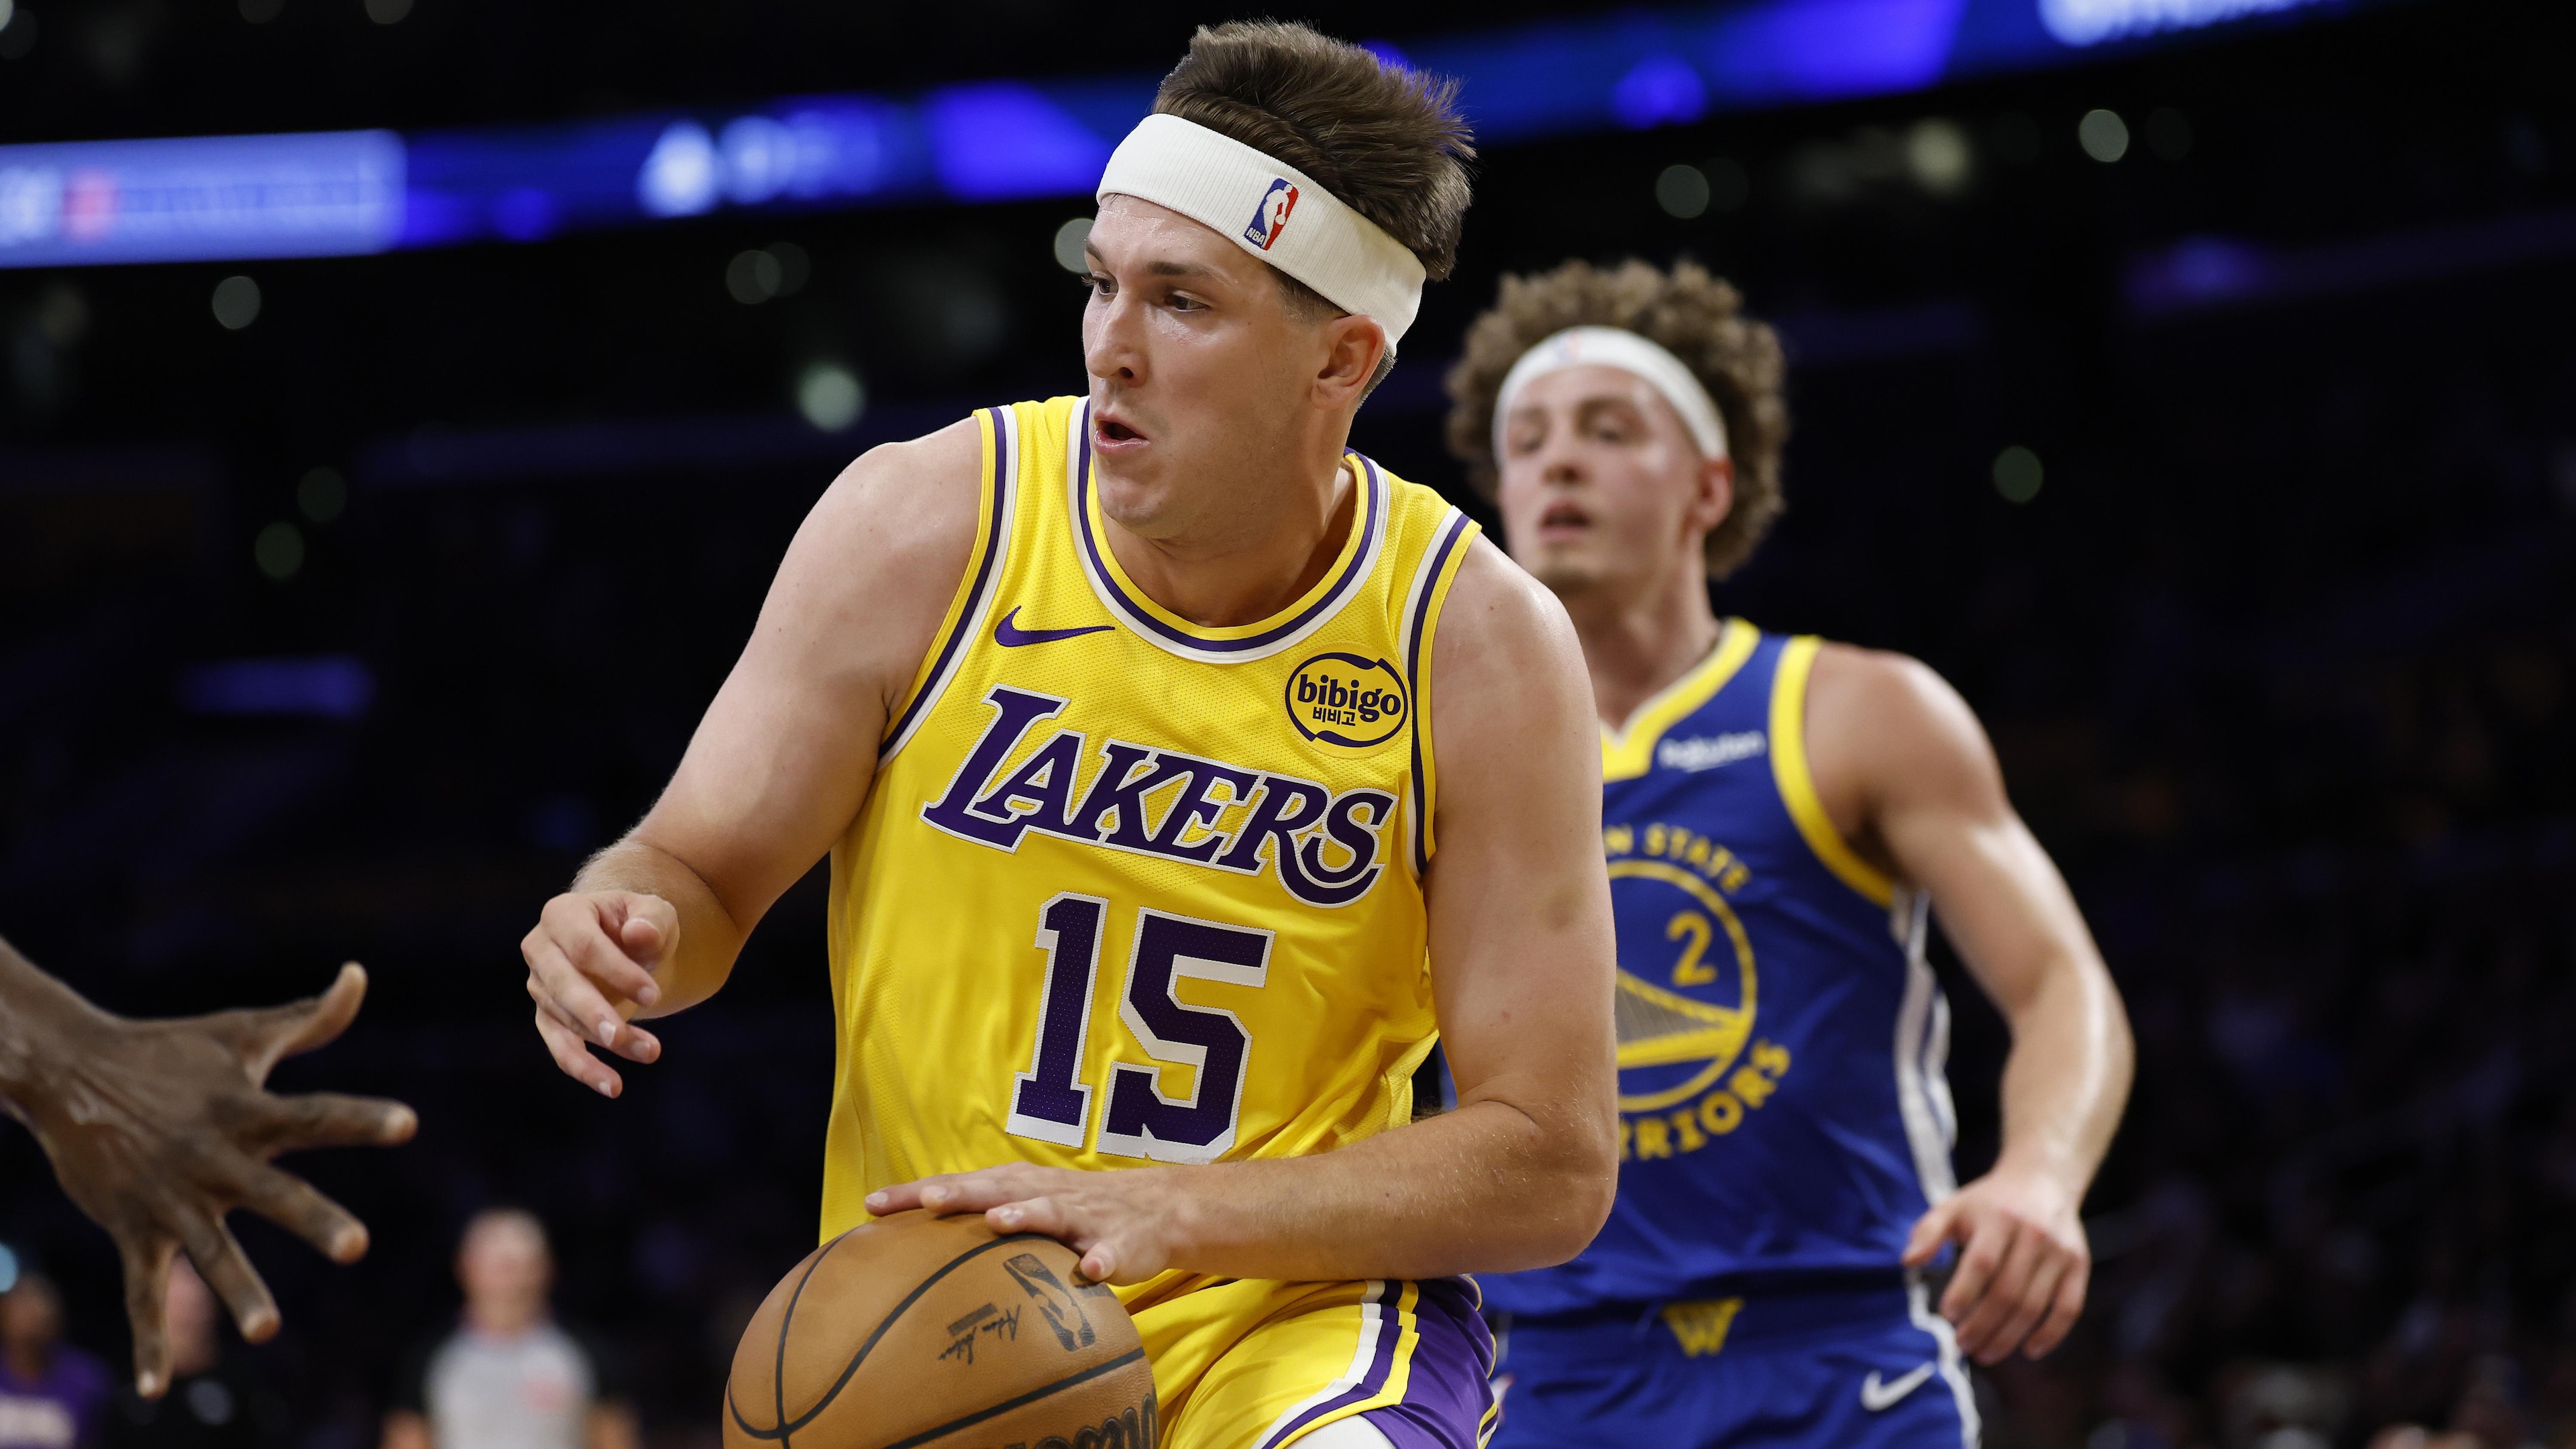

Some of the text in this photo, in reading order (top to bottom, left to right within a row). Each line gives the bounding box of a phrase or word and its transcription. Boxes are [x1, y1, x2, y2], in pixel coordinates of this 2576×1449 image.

[1246, 227, 1267, 245] NBA
[1297, 674, 1401, 722] bibigo
[1313, 706, 1356, 727] 비비고
[919, 683, 1399, 909] LAKERS
[1665, 909, 1719, 989] 2
[1006, 891, 1276, 1165] 15
